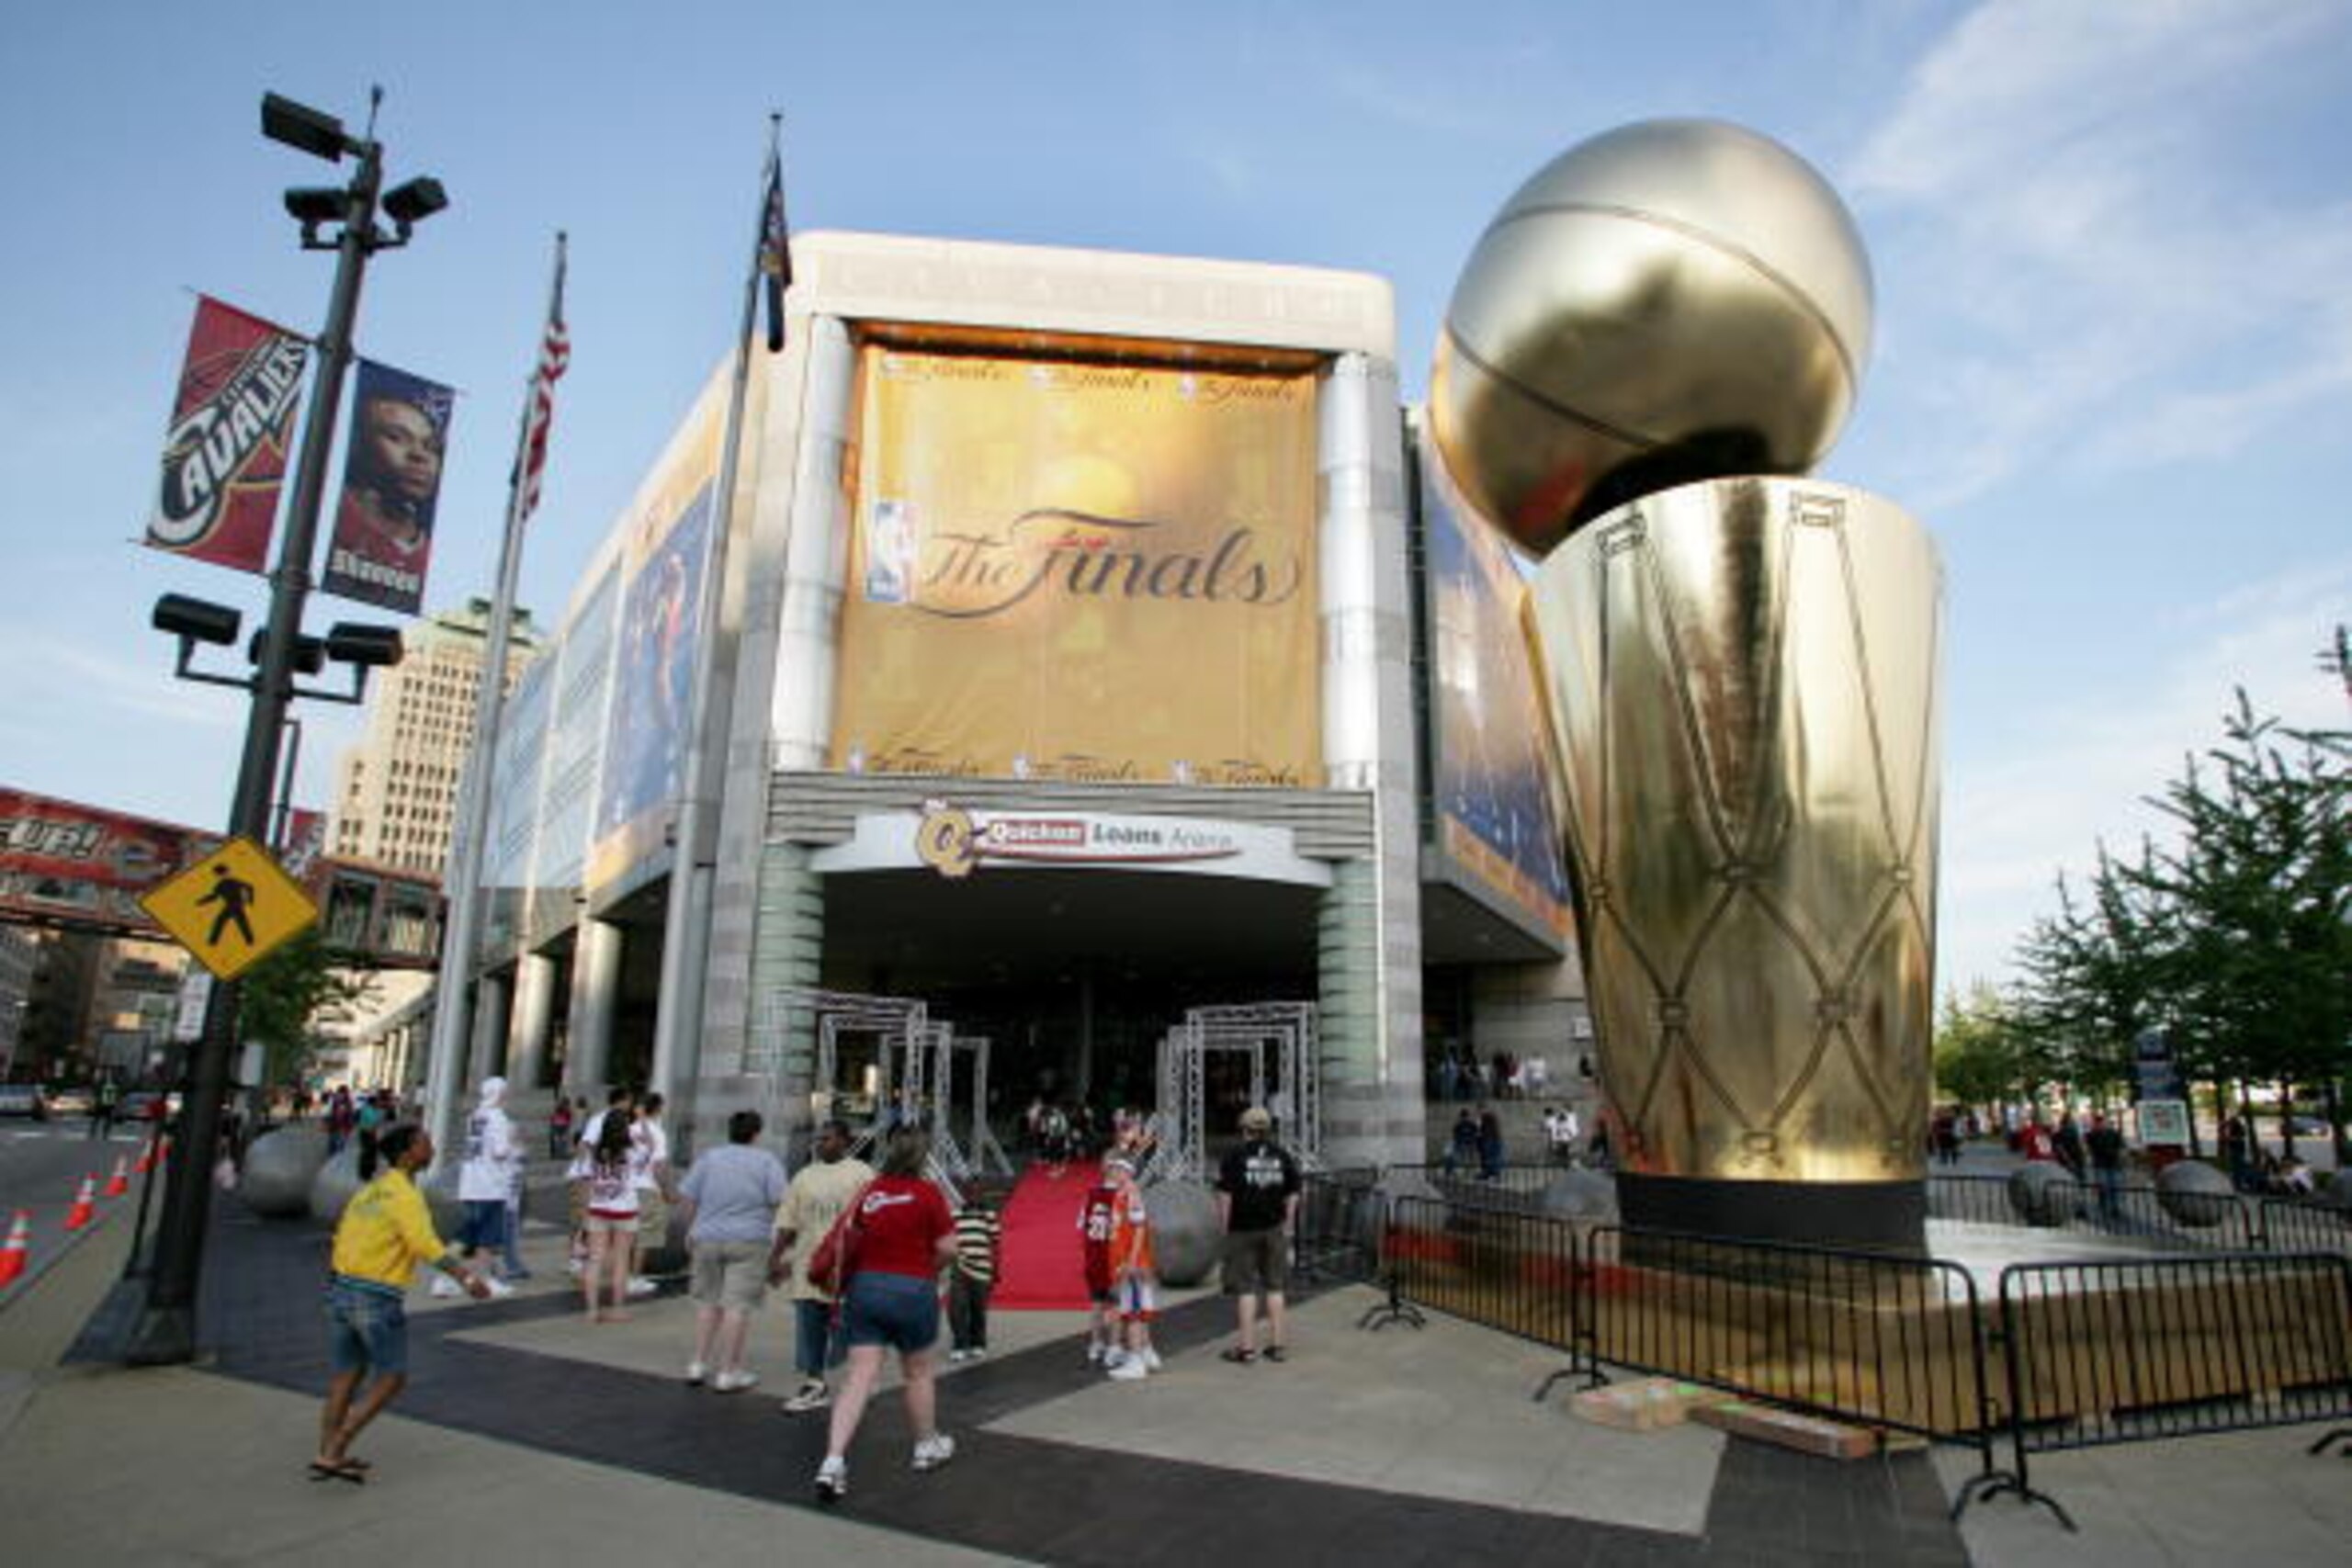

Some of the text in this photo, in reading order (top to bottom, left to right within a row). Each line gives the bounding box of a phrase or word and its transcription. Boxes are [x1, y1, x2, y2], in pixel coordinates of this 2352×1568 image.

[150, 336, 306, 542] CAVALIERS
[913, 507, 1303, 619] The Finals
[1092, 823, 1163, 845] Loans
